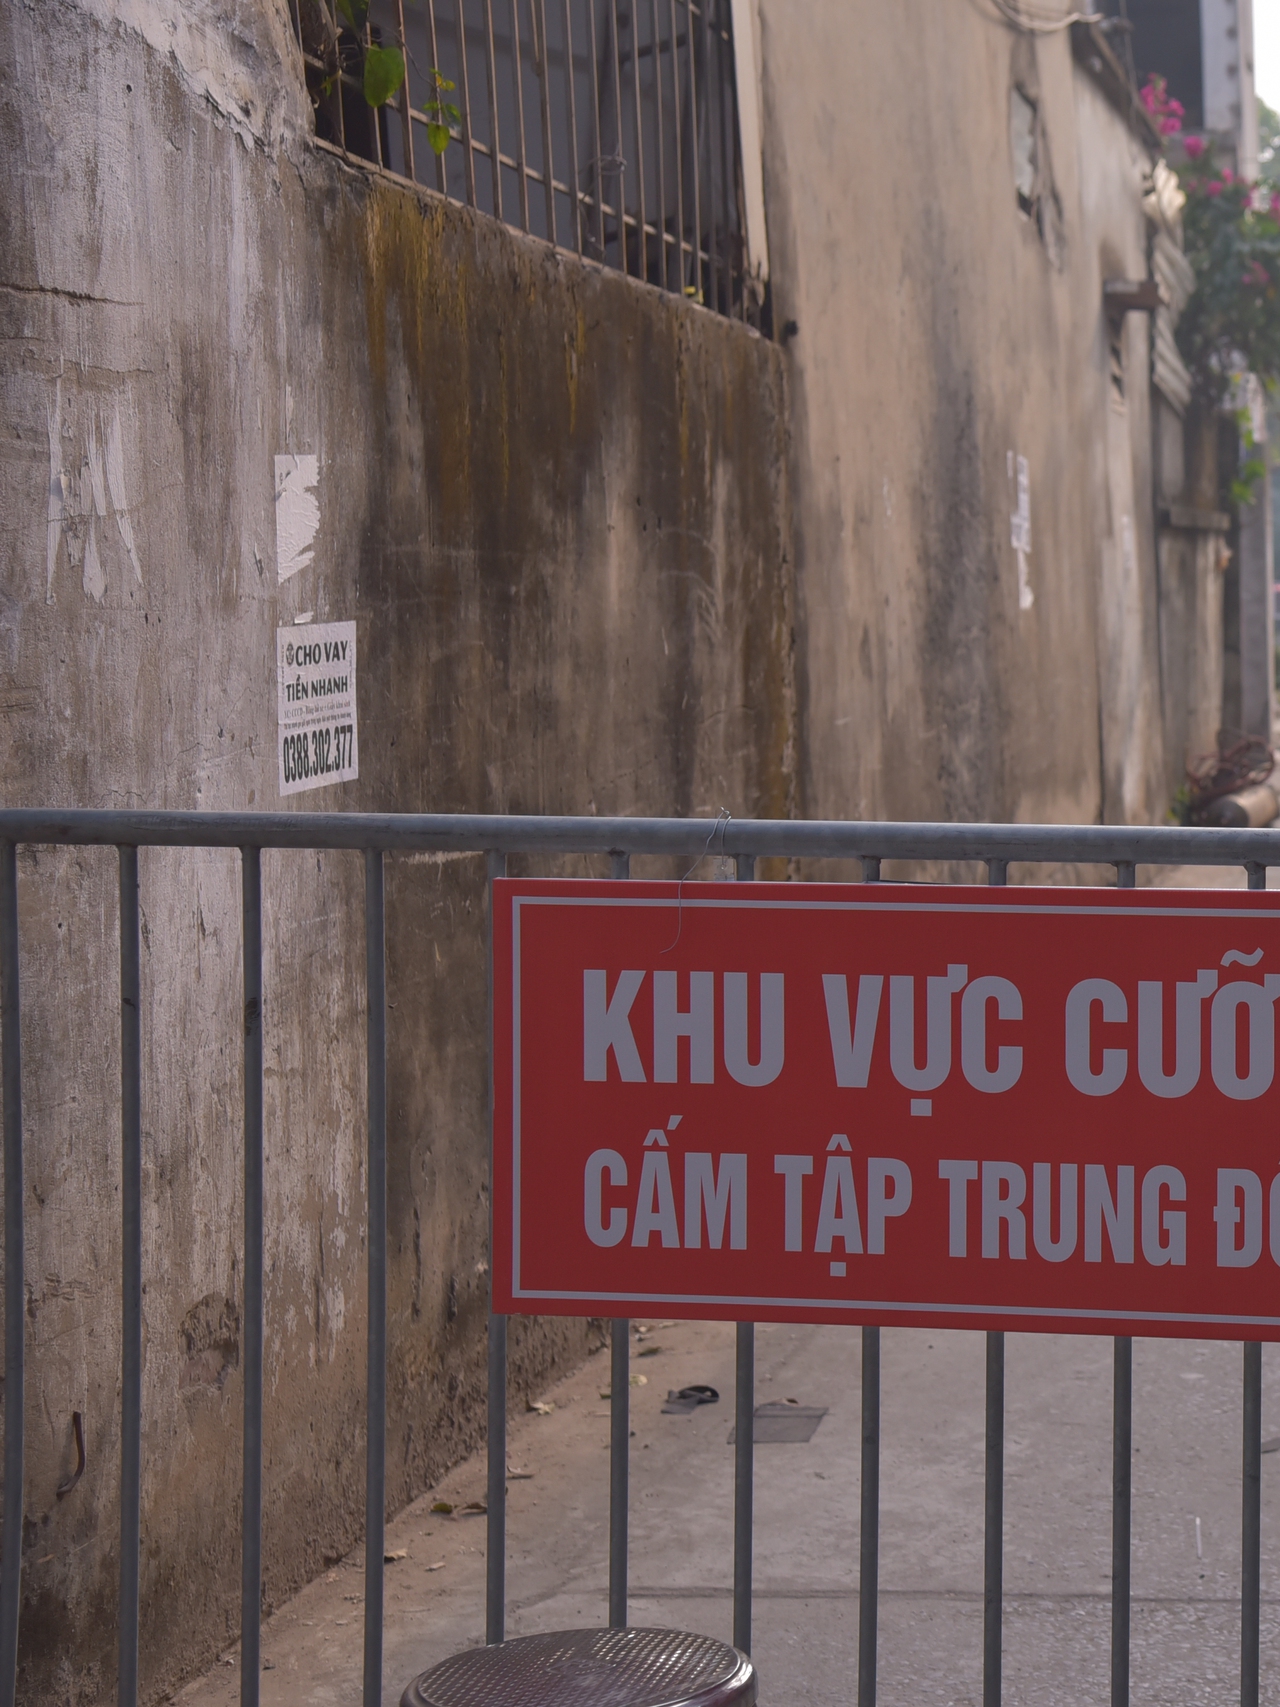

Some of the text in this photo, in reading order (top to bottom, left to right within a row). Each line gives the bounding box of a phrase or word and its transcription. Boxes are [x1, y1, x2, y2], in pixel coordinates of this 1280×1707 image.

[295, 643, 322, 667] CHO
[324, 640, 348, 663] VAY
[311, 675, 348, 698] NHANH
[283, 724, 353, 784] 0388.302.377
[583, 969, 785, 1087] KHU
[821, 963, 1023, 1117] VỰC
[583, 1115, 747, 1250] CẤM
[774, 1133, 913, 1277] TẬP
[938, 1159, 1187, 1267] TRUNG
